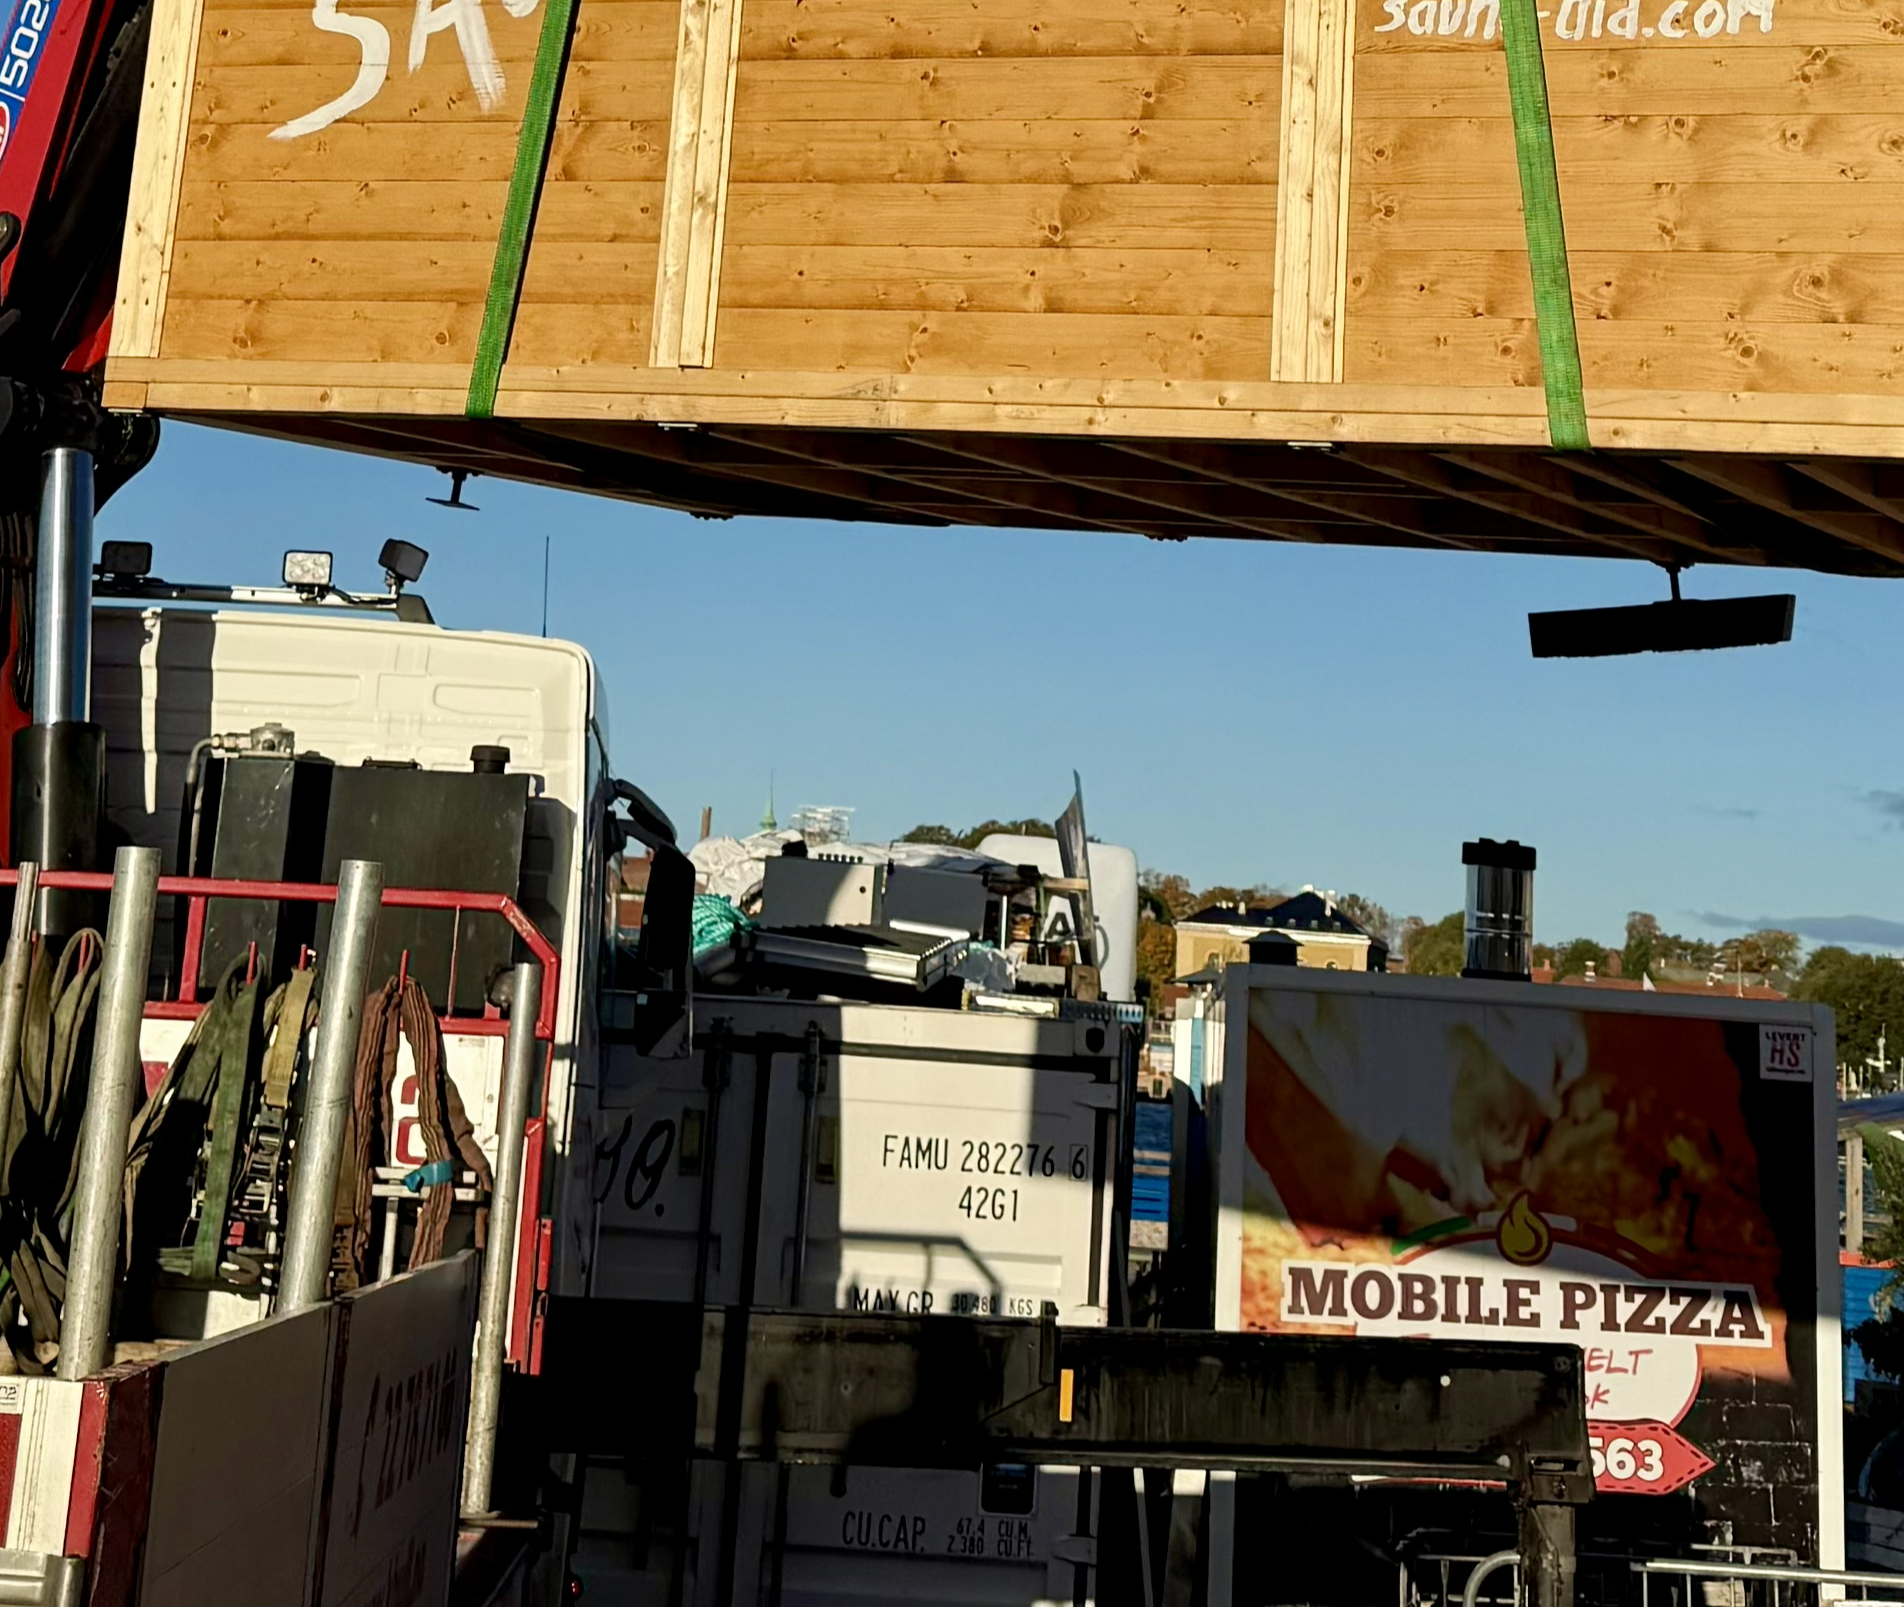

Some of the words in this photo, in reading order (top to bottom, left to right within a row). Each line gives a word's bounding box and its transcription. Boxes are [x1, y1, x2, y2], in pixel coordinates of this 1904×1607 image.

[882, 1134, 949, 1171] FAMU
[960, 1139, 1056, 1178] 282276
[1070, 1145, 1088, 1181] 6
[958, 1185, 1019, 1223] 42G1
[1286, 1265, 1542, 1329] MOBILE
[1559, 1281, 1766, 1340] PIZZA
[1584, 1346, 1653, 1376] ELT
